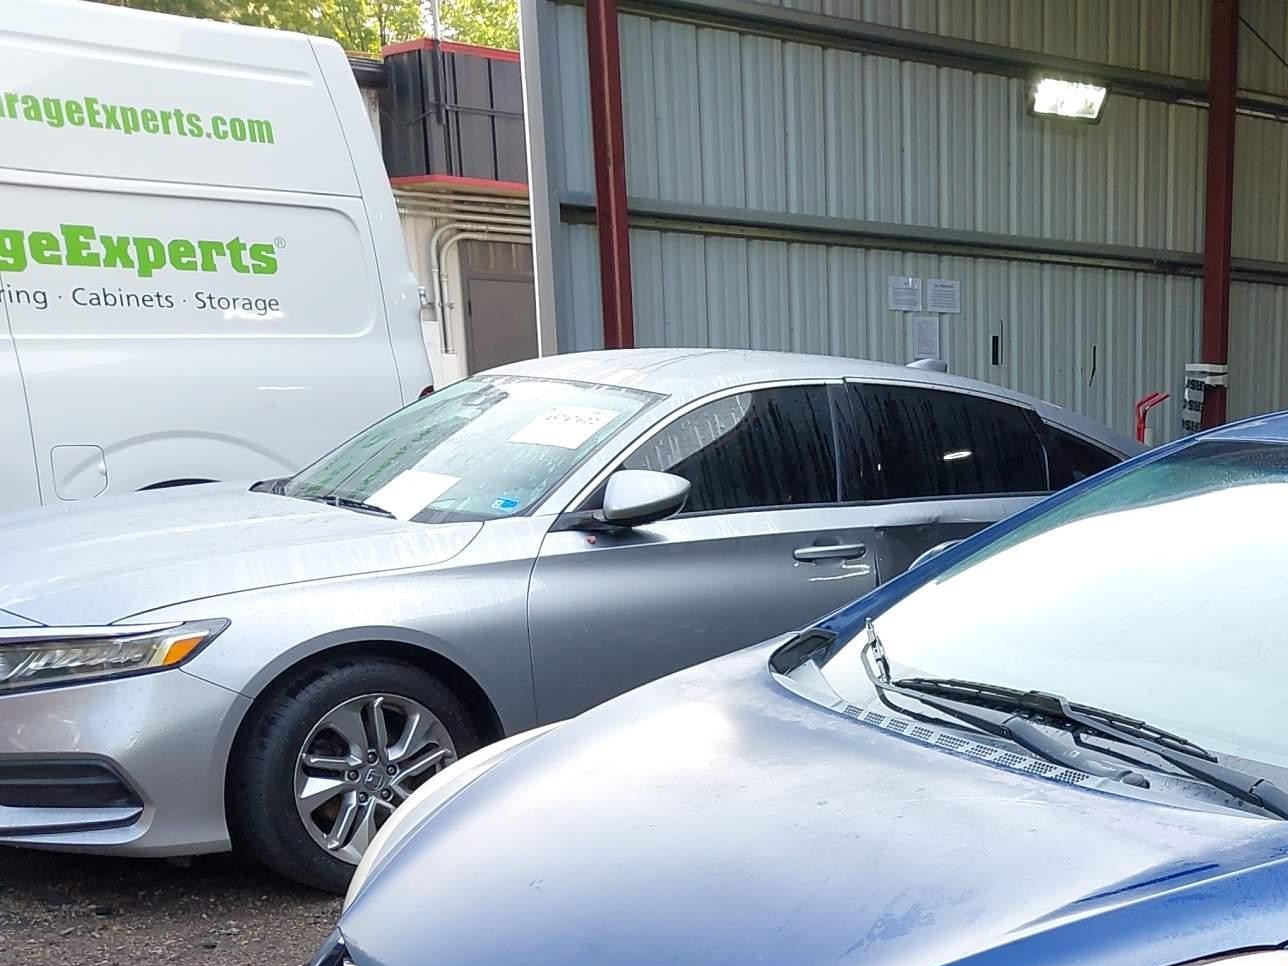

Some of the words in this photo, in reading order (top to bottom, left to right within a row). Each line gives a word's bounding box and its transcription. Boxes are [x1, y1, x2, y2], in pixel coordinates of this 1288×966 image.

[0, 91, 275, 145] rageExperts.com
[71, 287, 175, 309] Cabinets
[194, 291, 281, 316] Storage
